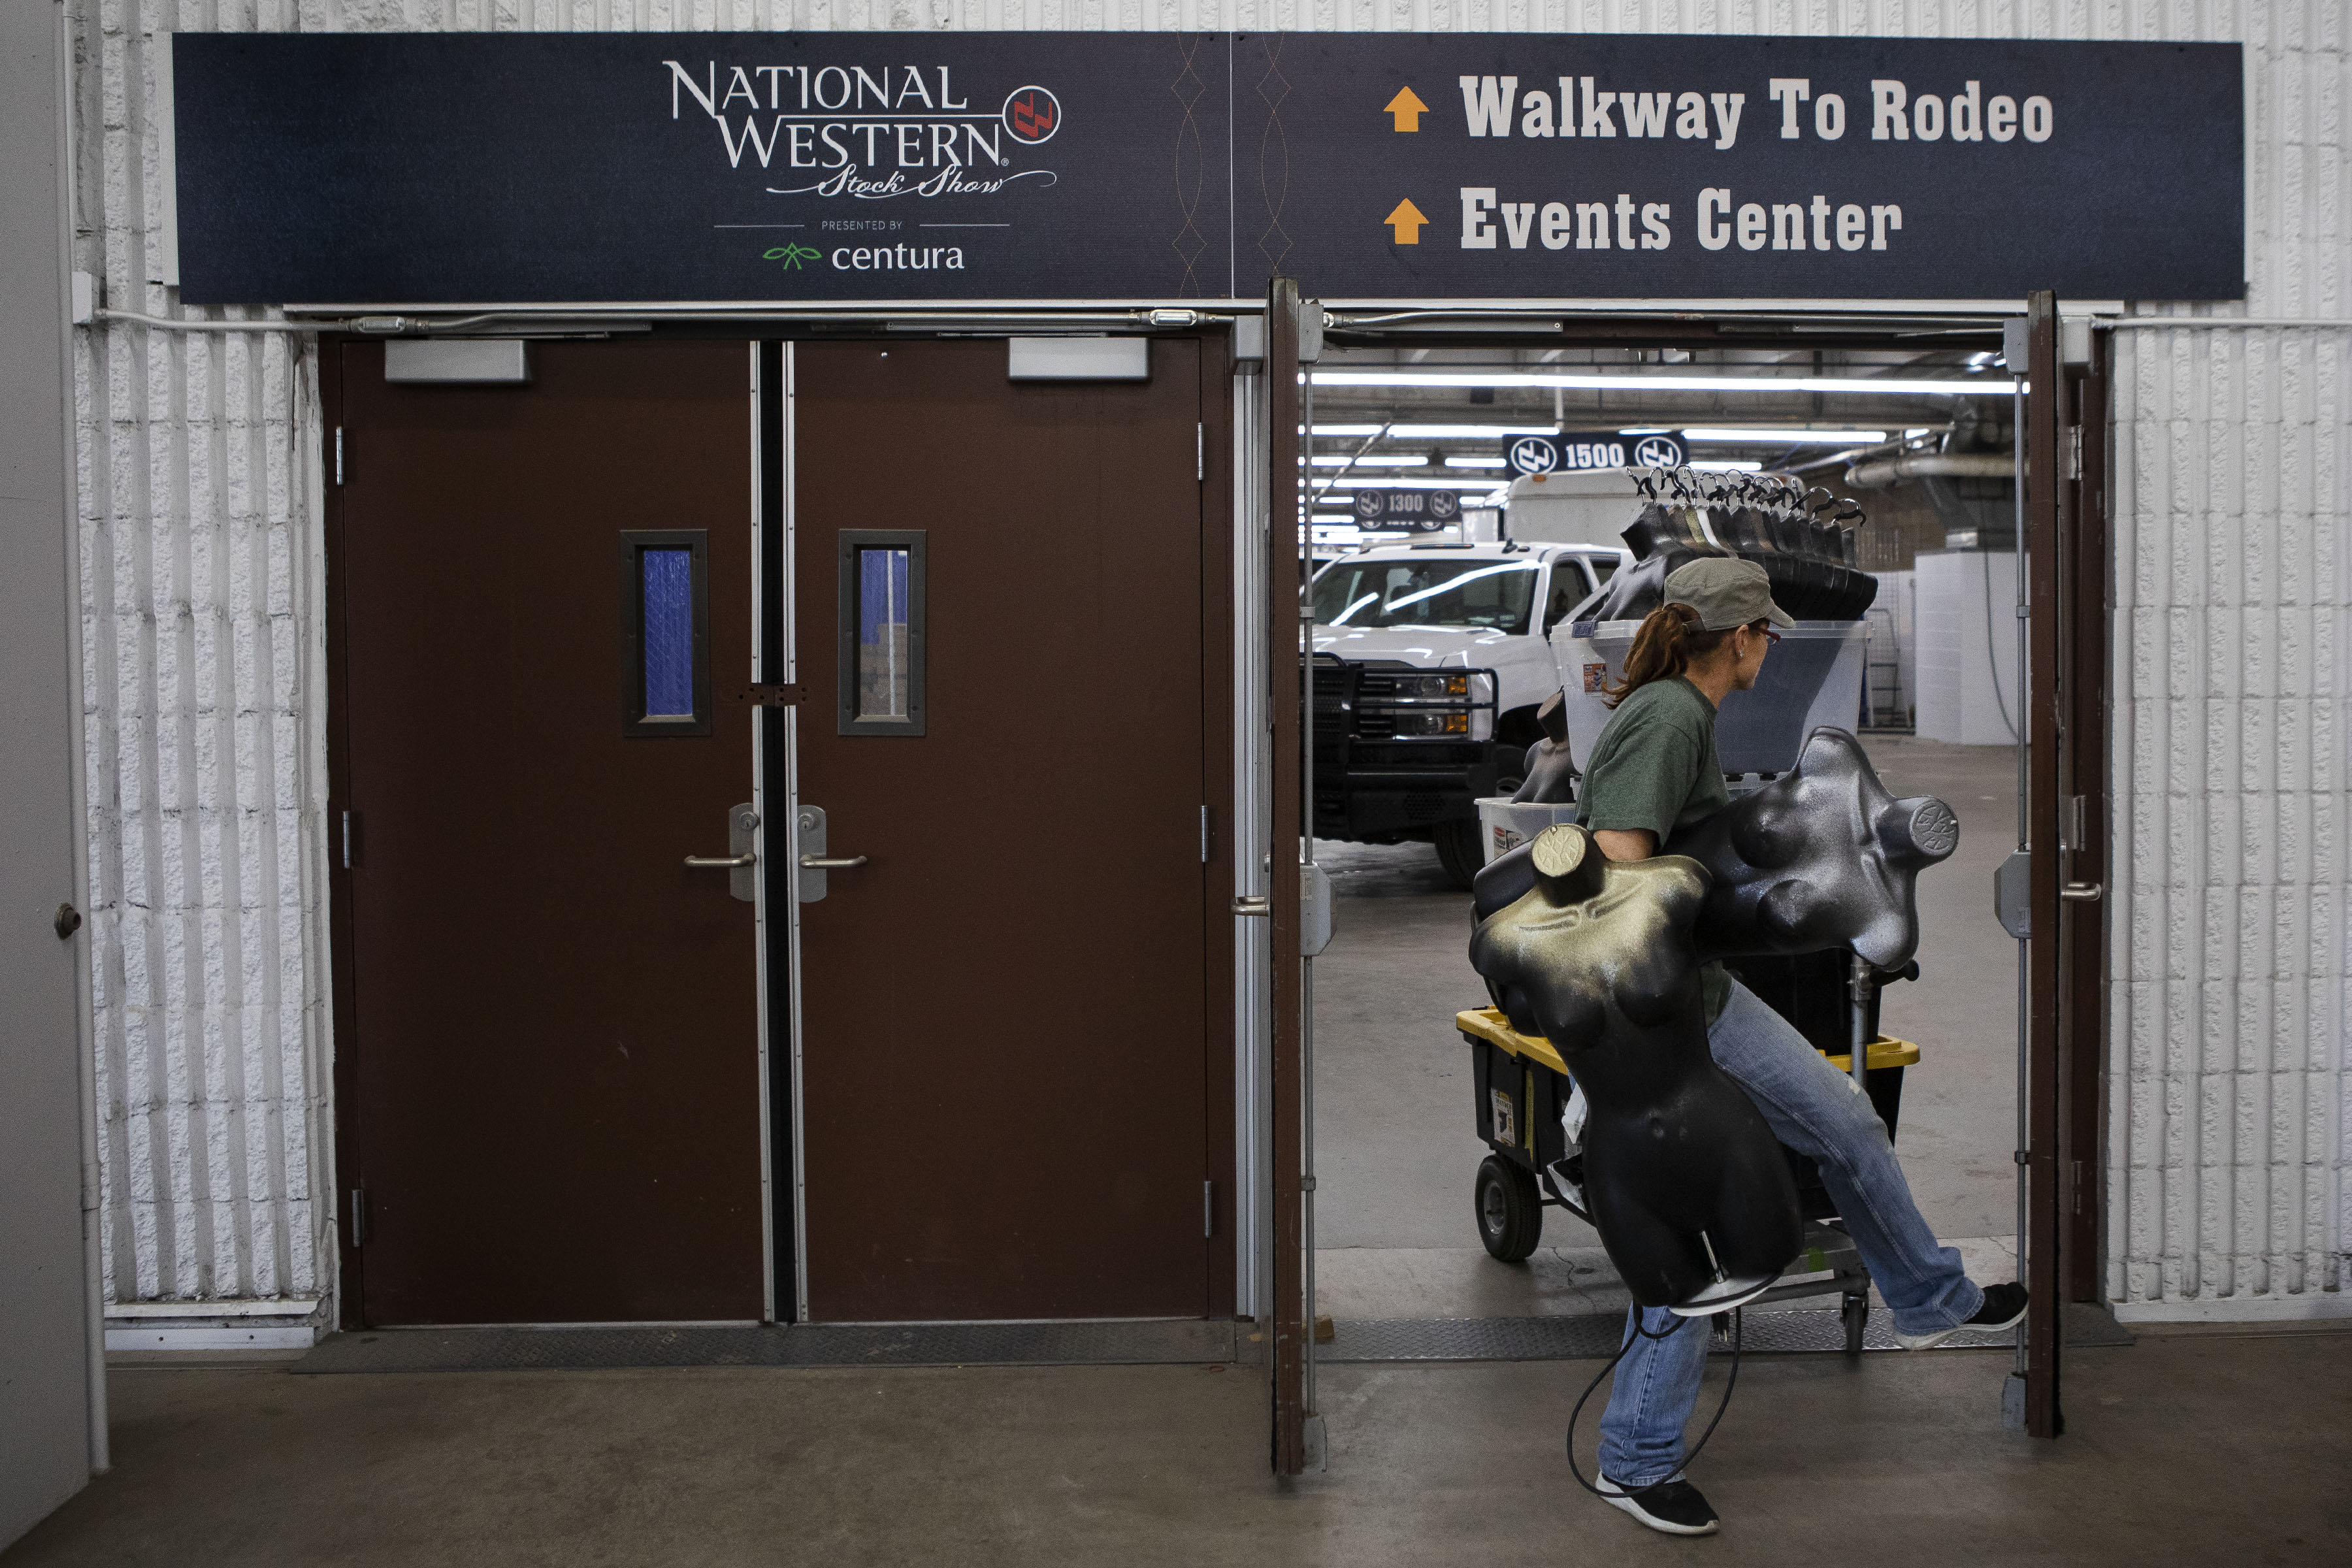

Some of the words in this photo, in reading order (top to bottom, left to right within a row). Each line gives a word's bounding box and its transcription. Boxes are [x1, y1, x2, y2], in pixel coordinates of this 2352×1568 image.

[662, 61, 968, 120] NATIONAL
[1459, 75, 1745, 150] Walkway
[1770, 78, 1846, 140] To
[1871, 79, 2053, 142] Rodeo
[817, 164, 906, 199] Stock
[916, 163, 1008, 197] Show
[821, 220, 886, 231] PRESENTED
[889, 220, 903, 231] BY
[1460, 187, 1671, 250] Events
[1697, 187, 1903, 252] Center
[832, 242, 965, 270] centura
[1565, 443, 1625, 468] 1500
[1389, 495, 1424, 512] 1300
